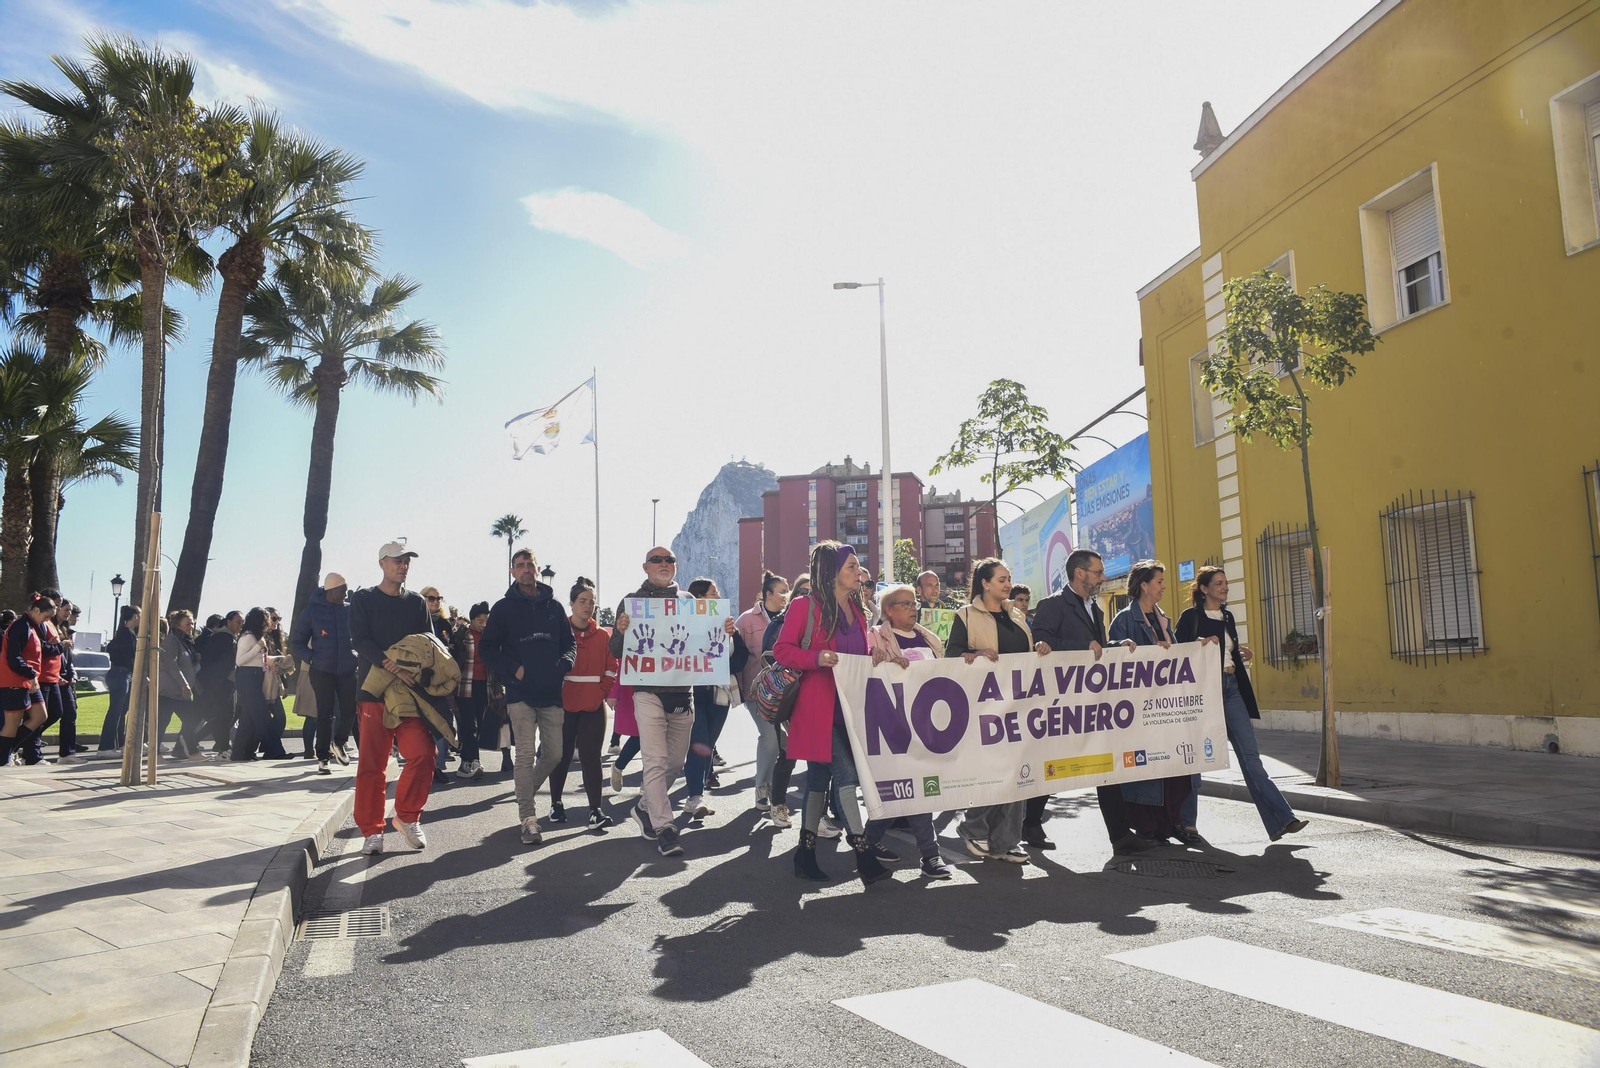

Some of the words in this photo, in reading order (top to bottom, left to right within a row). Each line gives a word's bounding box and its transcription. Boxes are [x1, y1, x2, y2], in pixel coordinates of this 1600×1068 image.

[1096, 483, 1130, 512] EMISIONES
[630, 598, 655, 618] EL
[664, 598, 719, 616] AMOR
[624, 654, 655, 675] NO
[661, 655, 714, 673] DUELE
[864, 676, 970, 756] NO
[977, 671, 1005, 703] A
[1011, 667, 1046, 700] LA
[1054, 656, 1196, 694] VIOLENCIA
[1143, 700, 1153, 711] 25
[1156, 694, 1204, 709] NOVIEMBRE
[979, 710, 1022, 745] DE
[1026, 698, 1134, 740] GÉNERO
[893, 781, 912, 798] 016
